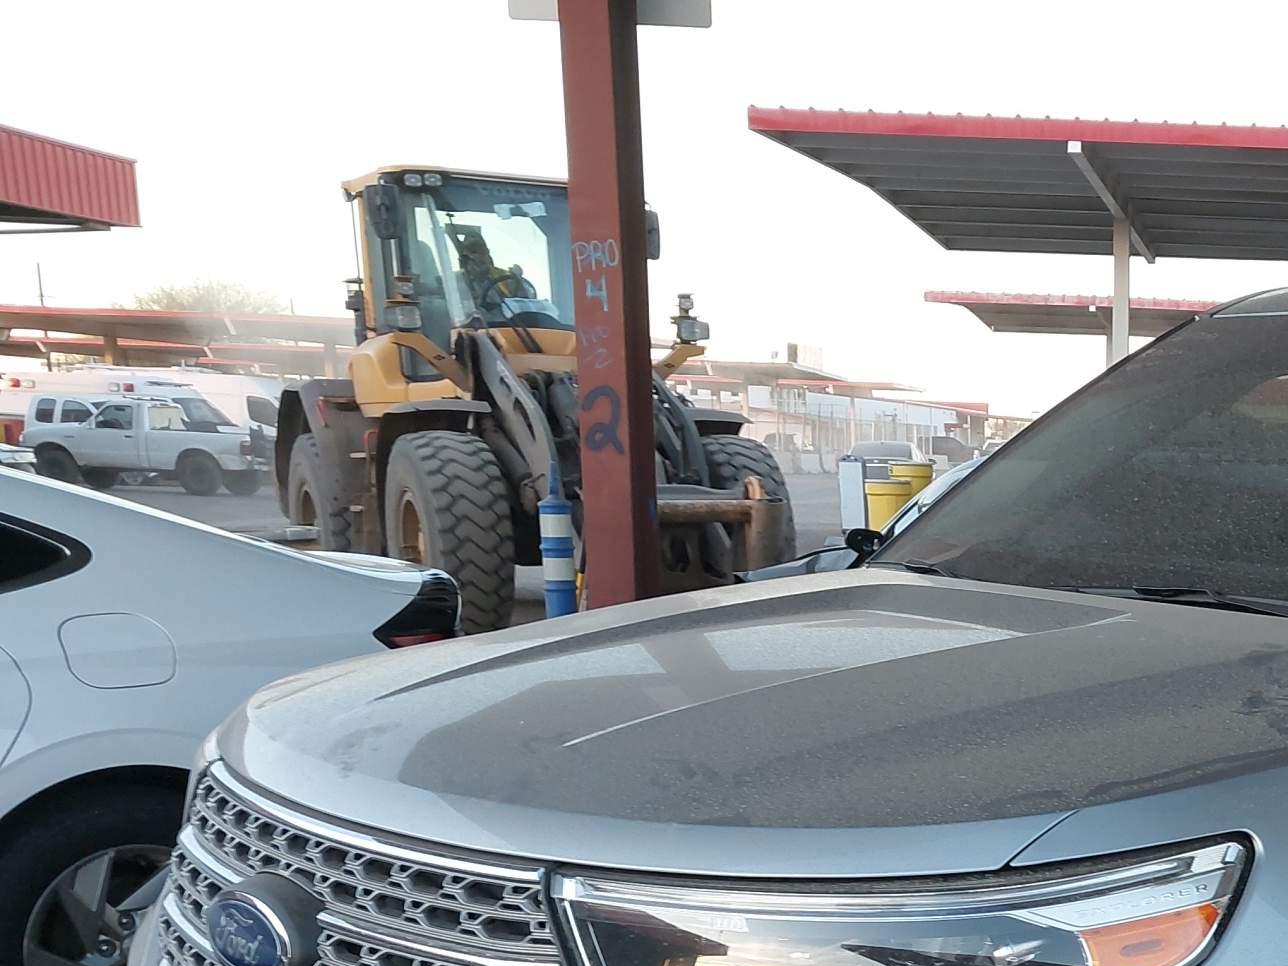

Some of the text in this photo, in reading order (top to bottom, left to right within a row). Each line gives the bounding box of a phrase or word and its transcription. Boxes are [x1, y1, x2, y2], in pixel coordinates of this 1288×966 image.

[585, 274, 609, 312] 4
[582, 384, 625, 456] 2
[216, 908, 264, 966] Ford
